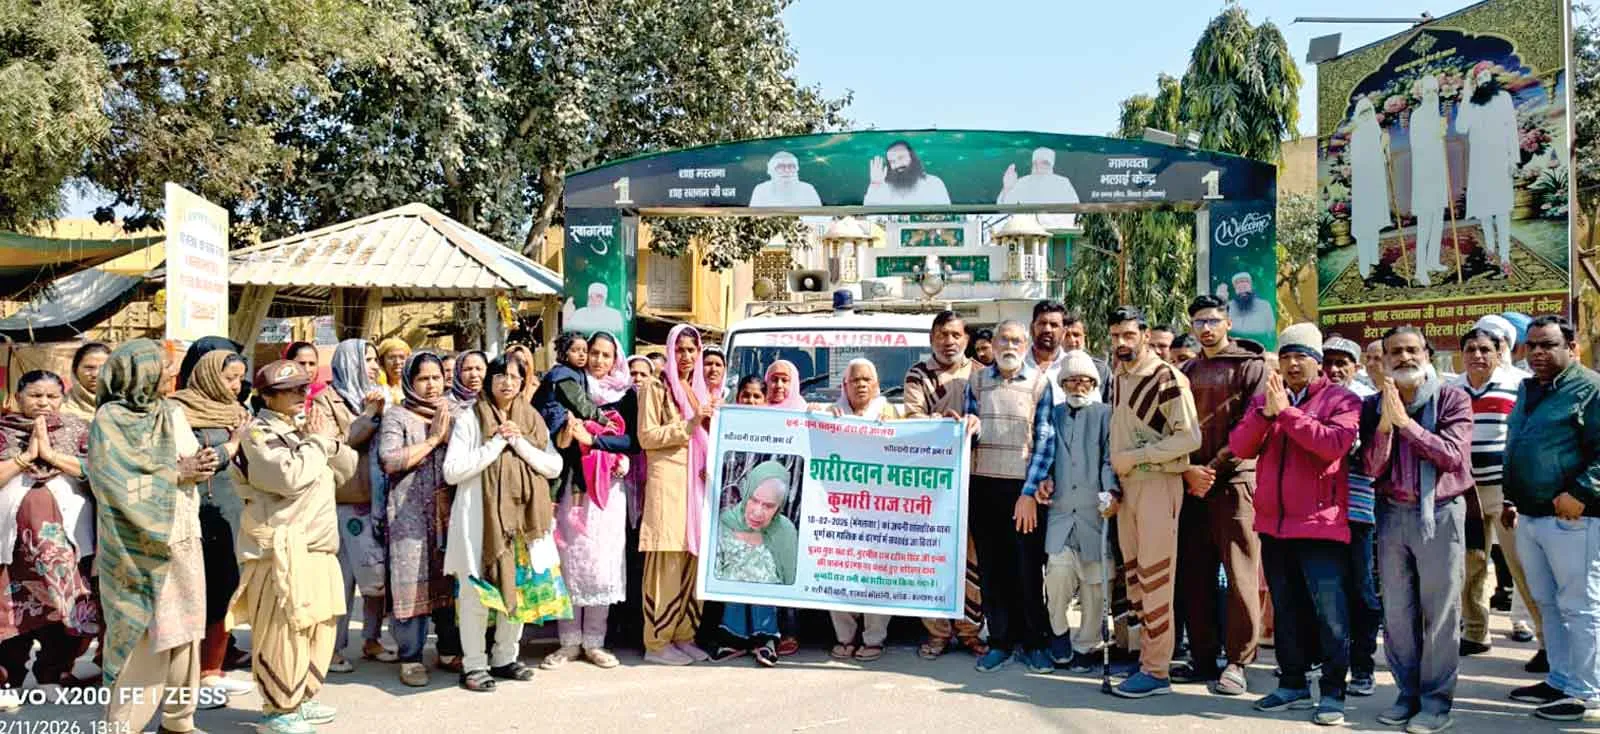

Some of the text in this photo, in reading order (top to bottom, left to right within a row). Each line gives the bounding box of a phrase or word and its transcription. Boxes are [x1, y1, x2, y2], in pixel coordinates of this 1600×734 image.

[1108, 157, 1149, 168] मानवता
[612, 176, 634, 204] 1
[1100, 170, 1130, 186] भलाई
[1201, 170, 1224, 199] 1
[1215, 211, 1272, 248] Welcome
[1373, 310, 1390, 321] शाह
[1422, 304, 1435, 320] जी
[1464, 303, 1503, 316] मानवता
[810, 453, 954, 490] शरीरदान महादान
[827, 490, 932, 516] कुमारी राज रानी
[813, 571, 832, 582] कुमारी
[833, 573, 845, 581] राज
[846, 573, 859, 583] रानी
